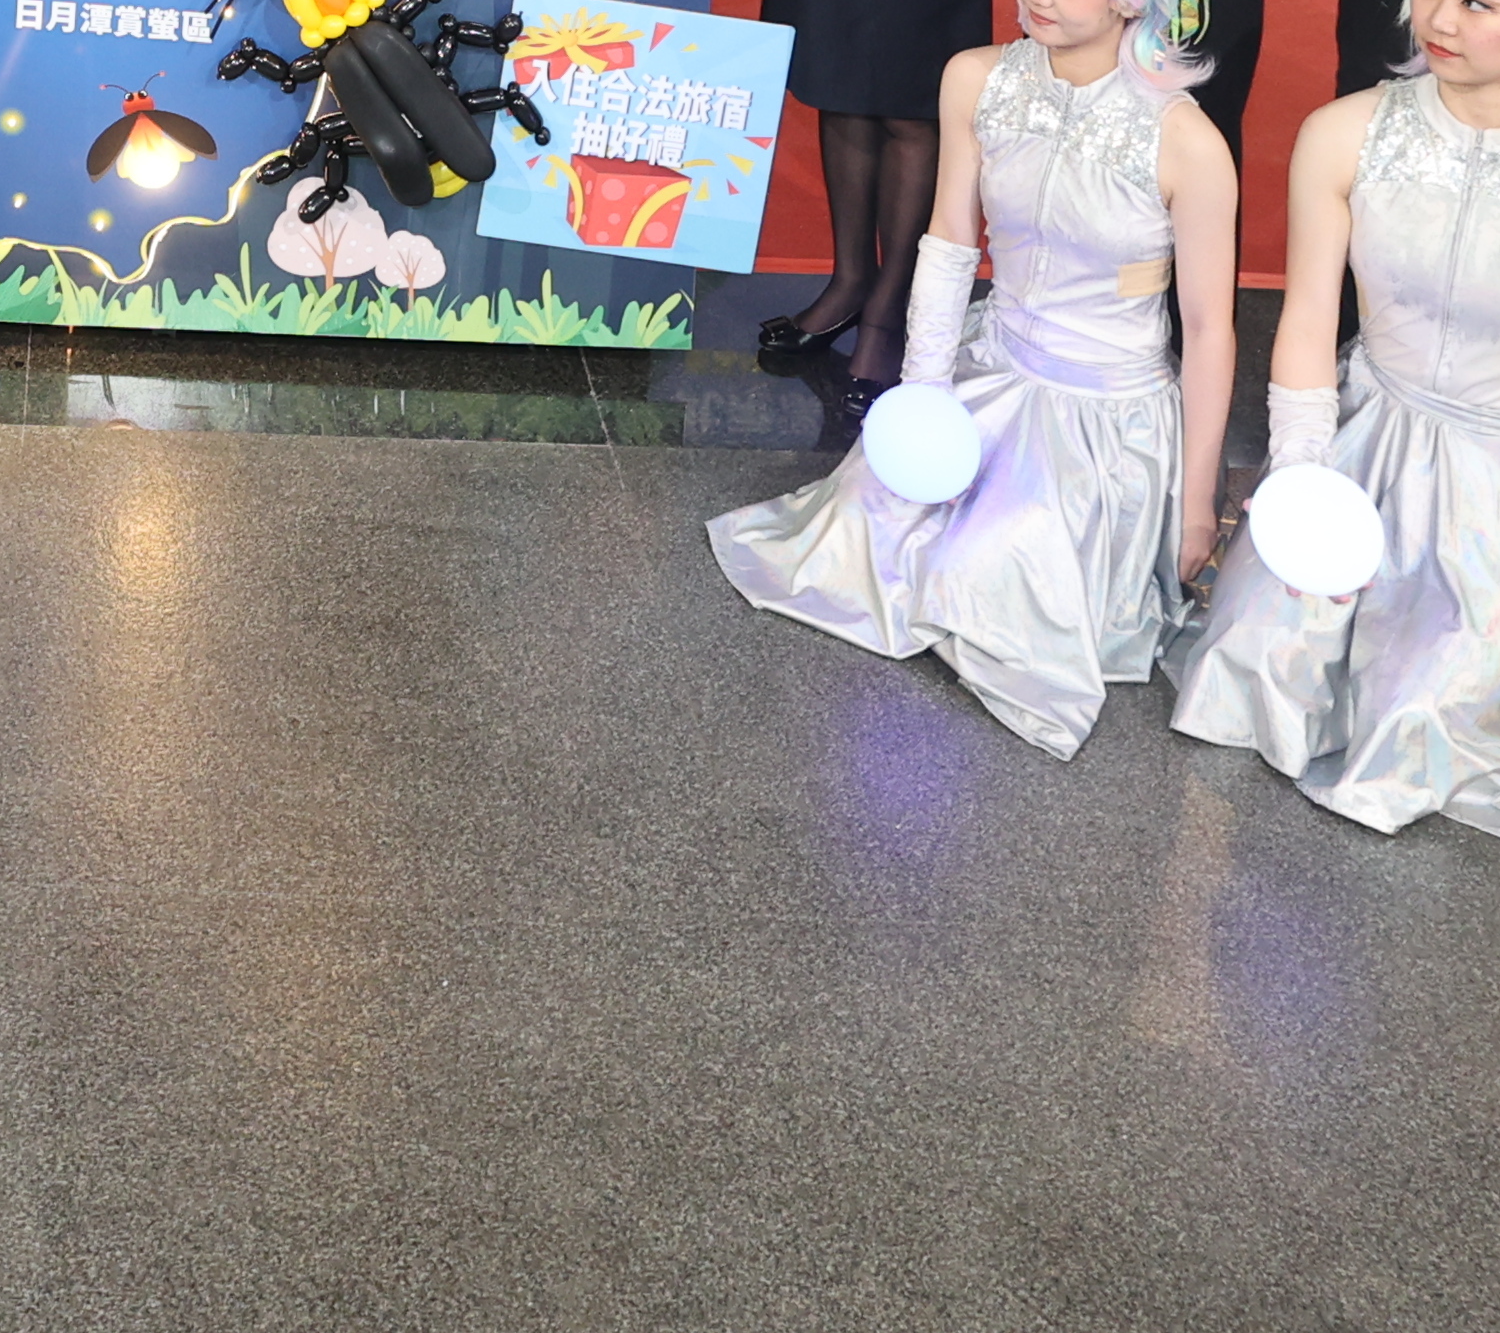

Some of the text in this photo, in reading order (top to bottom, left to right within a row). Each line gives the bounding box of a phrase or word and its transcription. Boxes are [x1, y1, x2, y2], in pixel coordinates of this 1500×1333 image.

[526, 58, 754, 131] 入住合法旅宿
[571, 112, 688, 167] 抽好禮
